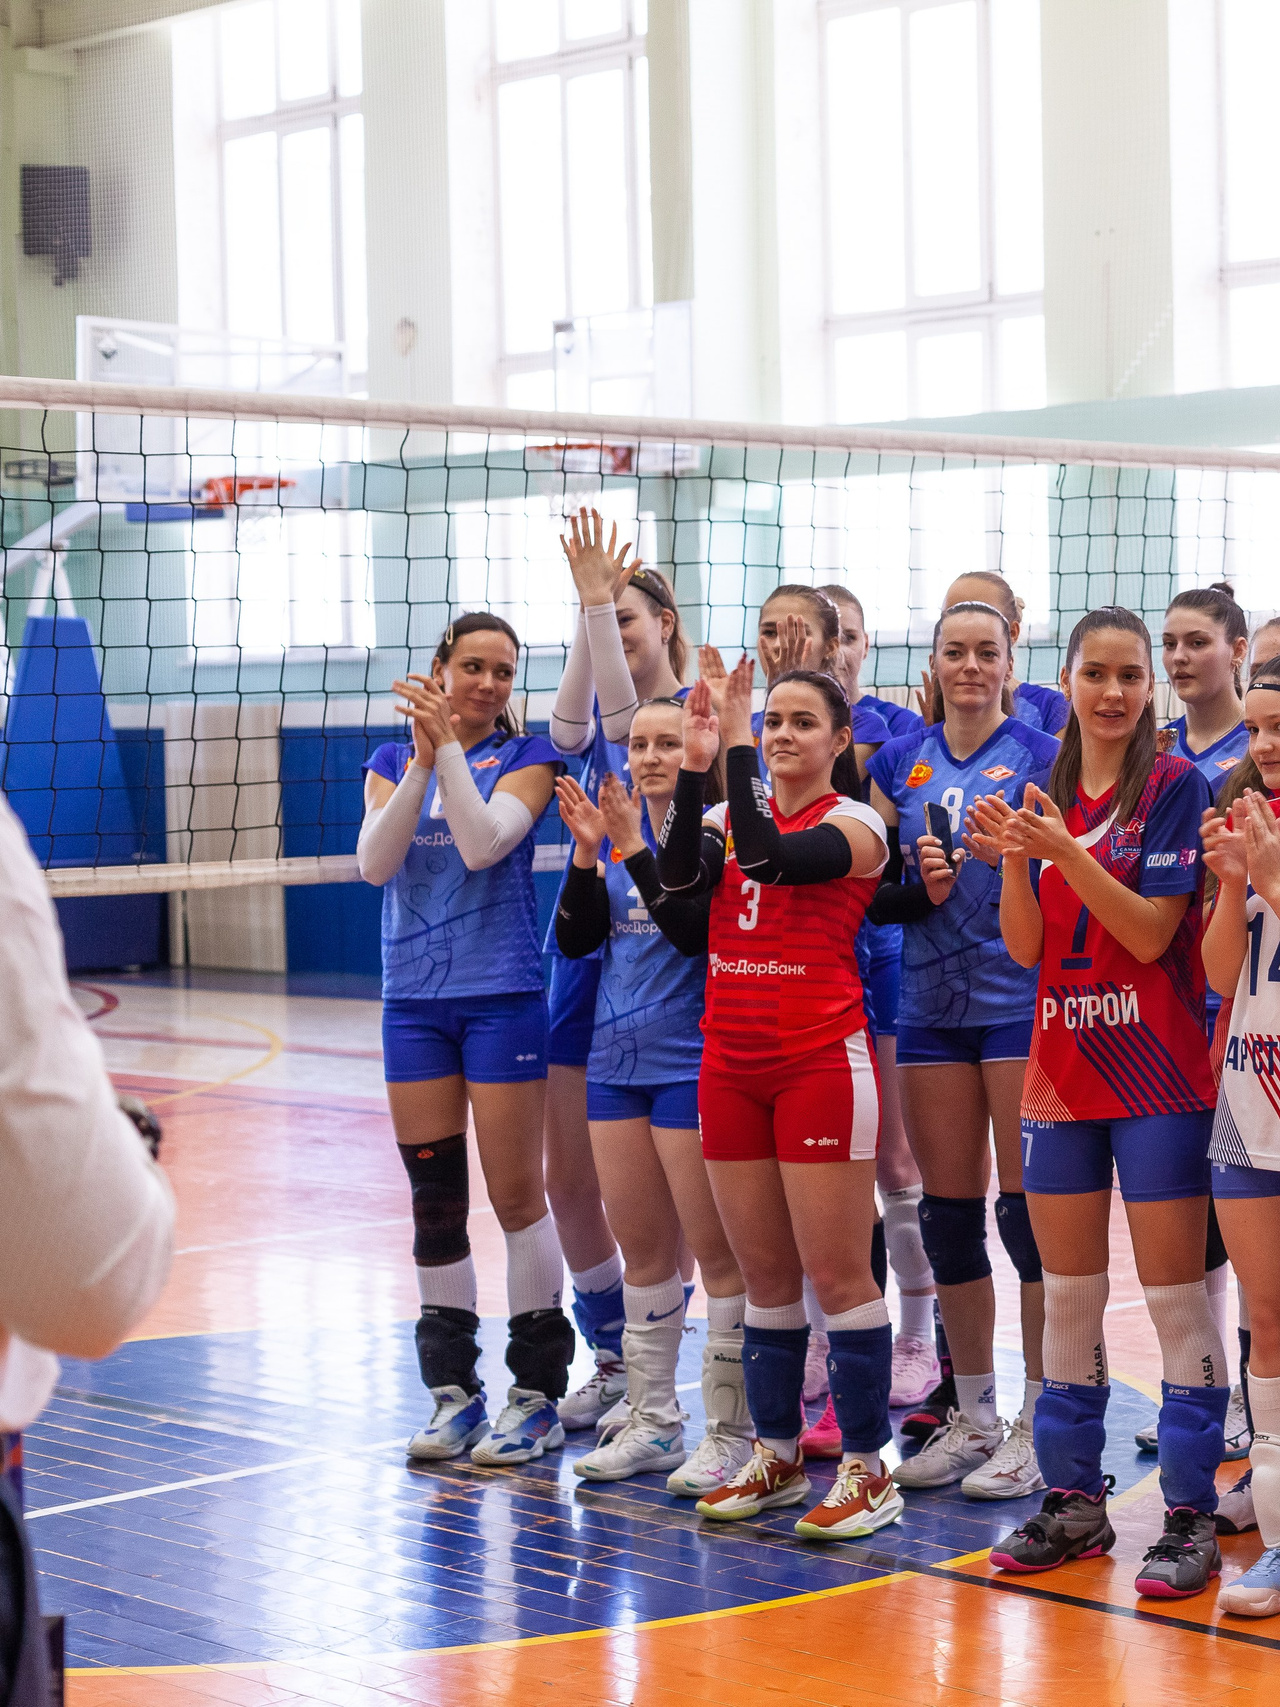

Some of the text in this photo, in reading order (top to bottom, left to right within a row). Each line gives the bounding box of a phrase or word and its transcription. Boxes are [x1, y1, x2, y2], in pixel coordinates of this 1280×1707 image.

[941, 787, 964, 834] 8
[738, 879, 761, 931] 3
[615, 920, 662, 935] РосДор
[716, 958, 807, 977] РосДорБанк
[1022, 1131, 1034, 1167] 7
[1201, 1354, 1215, 1388] KASA
